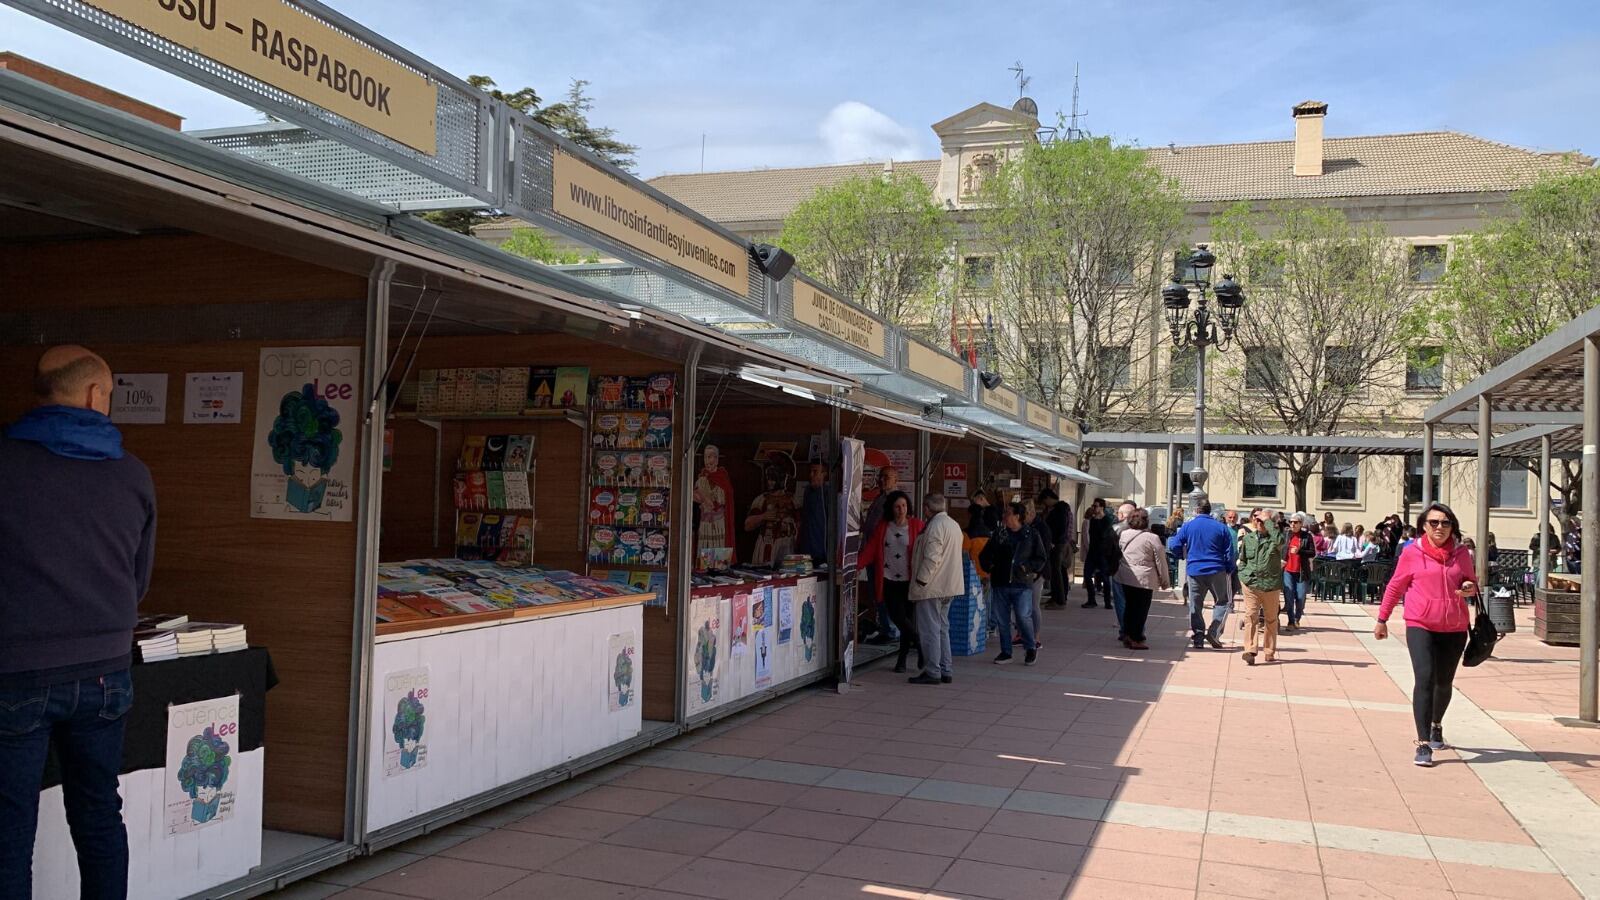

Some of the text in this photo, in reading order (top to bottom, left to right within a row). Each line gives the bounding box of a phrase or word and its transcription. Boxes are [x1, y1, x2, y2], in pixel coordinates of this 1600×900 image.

[251, 18, 391, 116] RASPABOOK
[570, 182, 736, 278] www.librosinfantilesyjuveniles.com
[812, 291, 873, 336] JUNTA DE COMUNIDADES DE
[818, 312, 842, 338] CASTILLA
[263, 354, 353, 377] Cuenca
[126, 389, 153, 405] 10%
[313, 378, 353, 400] Lee
[172, 704, 237, 728] Cuenca
[212, 722, 237, 737] Lee
